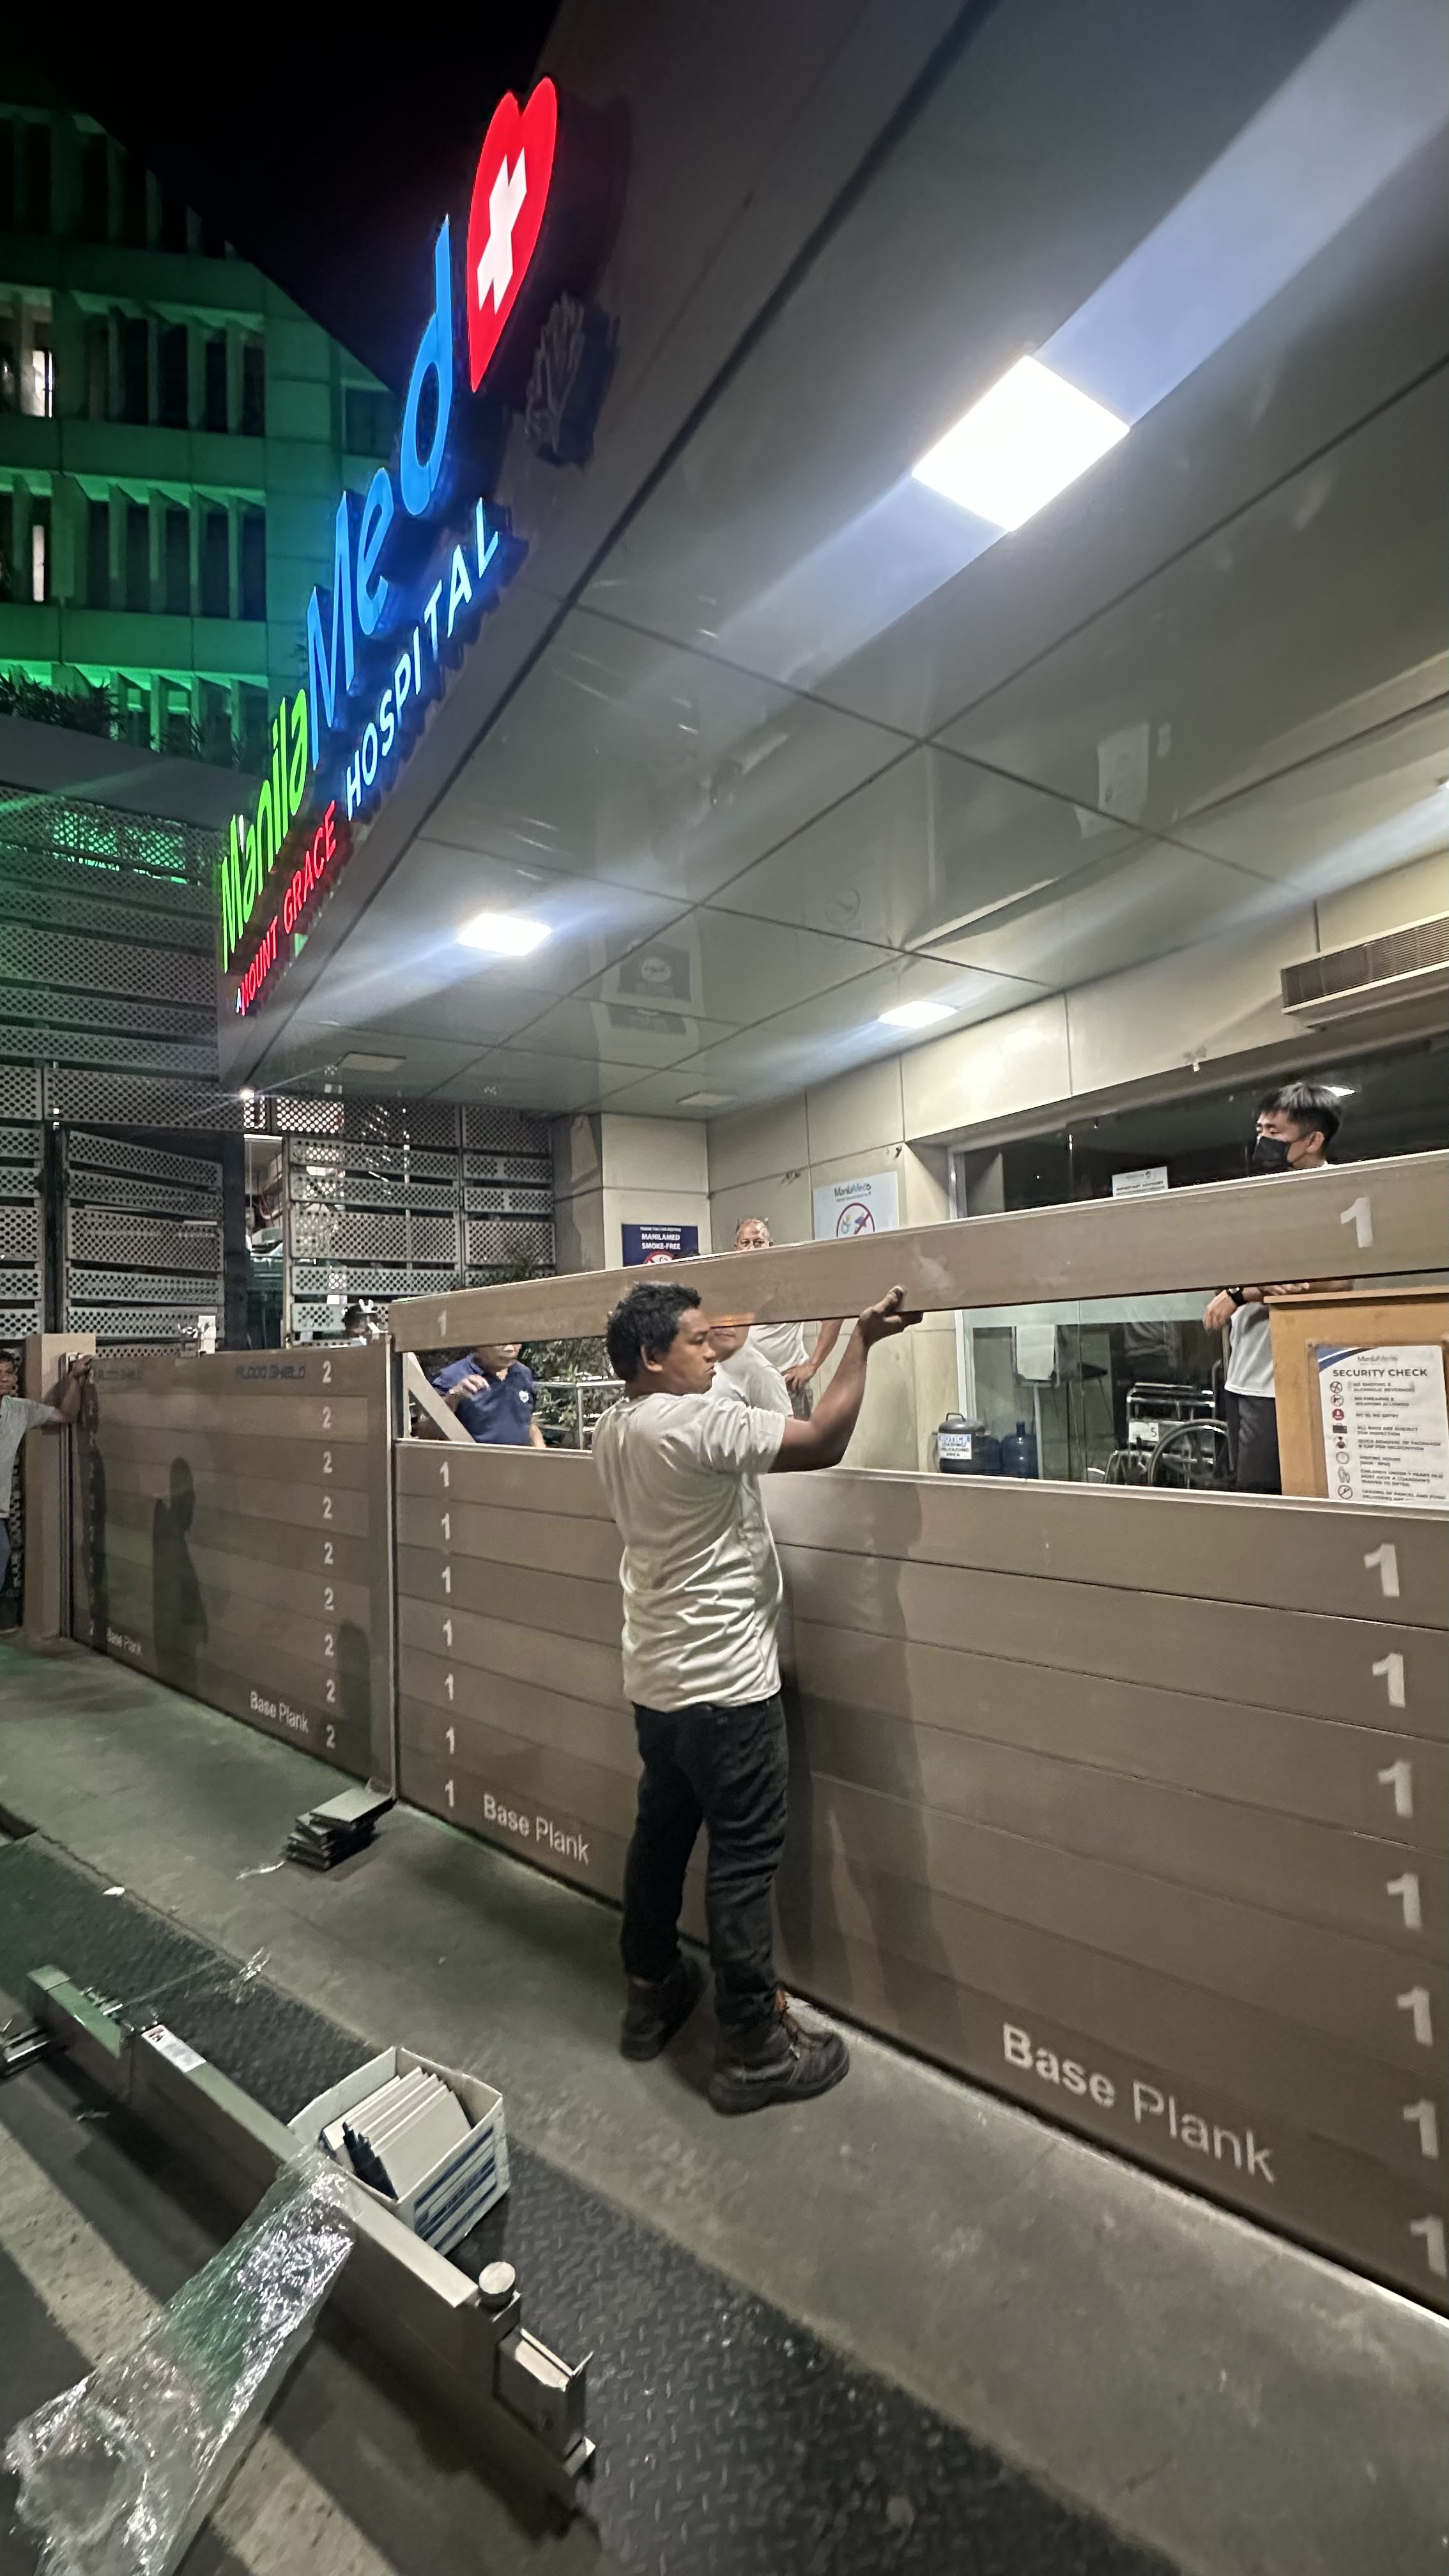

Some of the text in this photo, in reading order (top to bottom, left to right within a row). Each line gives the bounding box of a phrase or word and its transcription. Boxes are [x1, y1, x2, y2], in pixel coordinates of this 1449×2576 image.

[222, 213, 453, 973] ManilaMed
[234, 497, 499, 1016] A MOUNT GRACE HOSPITAL
[1340, 1197, 1373, 1248] 1
[438, 1310, 447, 1337] 1
[322, 1360, 332, 1384] 2
[1333, 1368, 1428, 1377] SECURITY CHECK
[322, 1406, 332, 1429] 2
[1151, 1427, 1157, 1438] 5
[323, 1451, 333, 1474] 2
[439, 1461, 450, 1488] 1
[323, 1496, 333, 1520] 2
[441, 1512, 450, 1540] 1
[323, 1542, 334, 1565] 2
[441, 1566, 452, 1594] 1
[1363, 1543, 1400, 1598] 1
[324, 1586, 335, 1611] 2
[324, 1633, 334, 1657] 2
[442, 1619, 453, 1647] 1
[326, 1678, 336, 1703] 2
[444, 1673, 454, 1701] 1
[1372, 1652, 1406, 1708] 1
[250, 1690, 309, 1734] Base Plank
[326, 1724, 336, 1749] 2
[445, 1726, 456, 1755] 1
[444, 1779, 455, 1809] 1
[1377, 1759, 1413, 1818] 1
[483, 1792, 590, 1866] Base Plank
[1386, 1873, 1422, 1929] 1
[1396, 1986, 1433, 2047] 1
[1002, 2022, 1275, 2184] Base Plank
[1402, 2099, 1439, 2159] 1
[1409, 2215, 1448, 2278] 1
